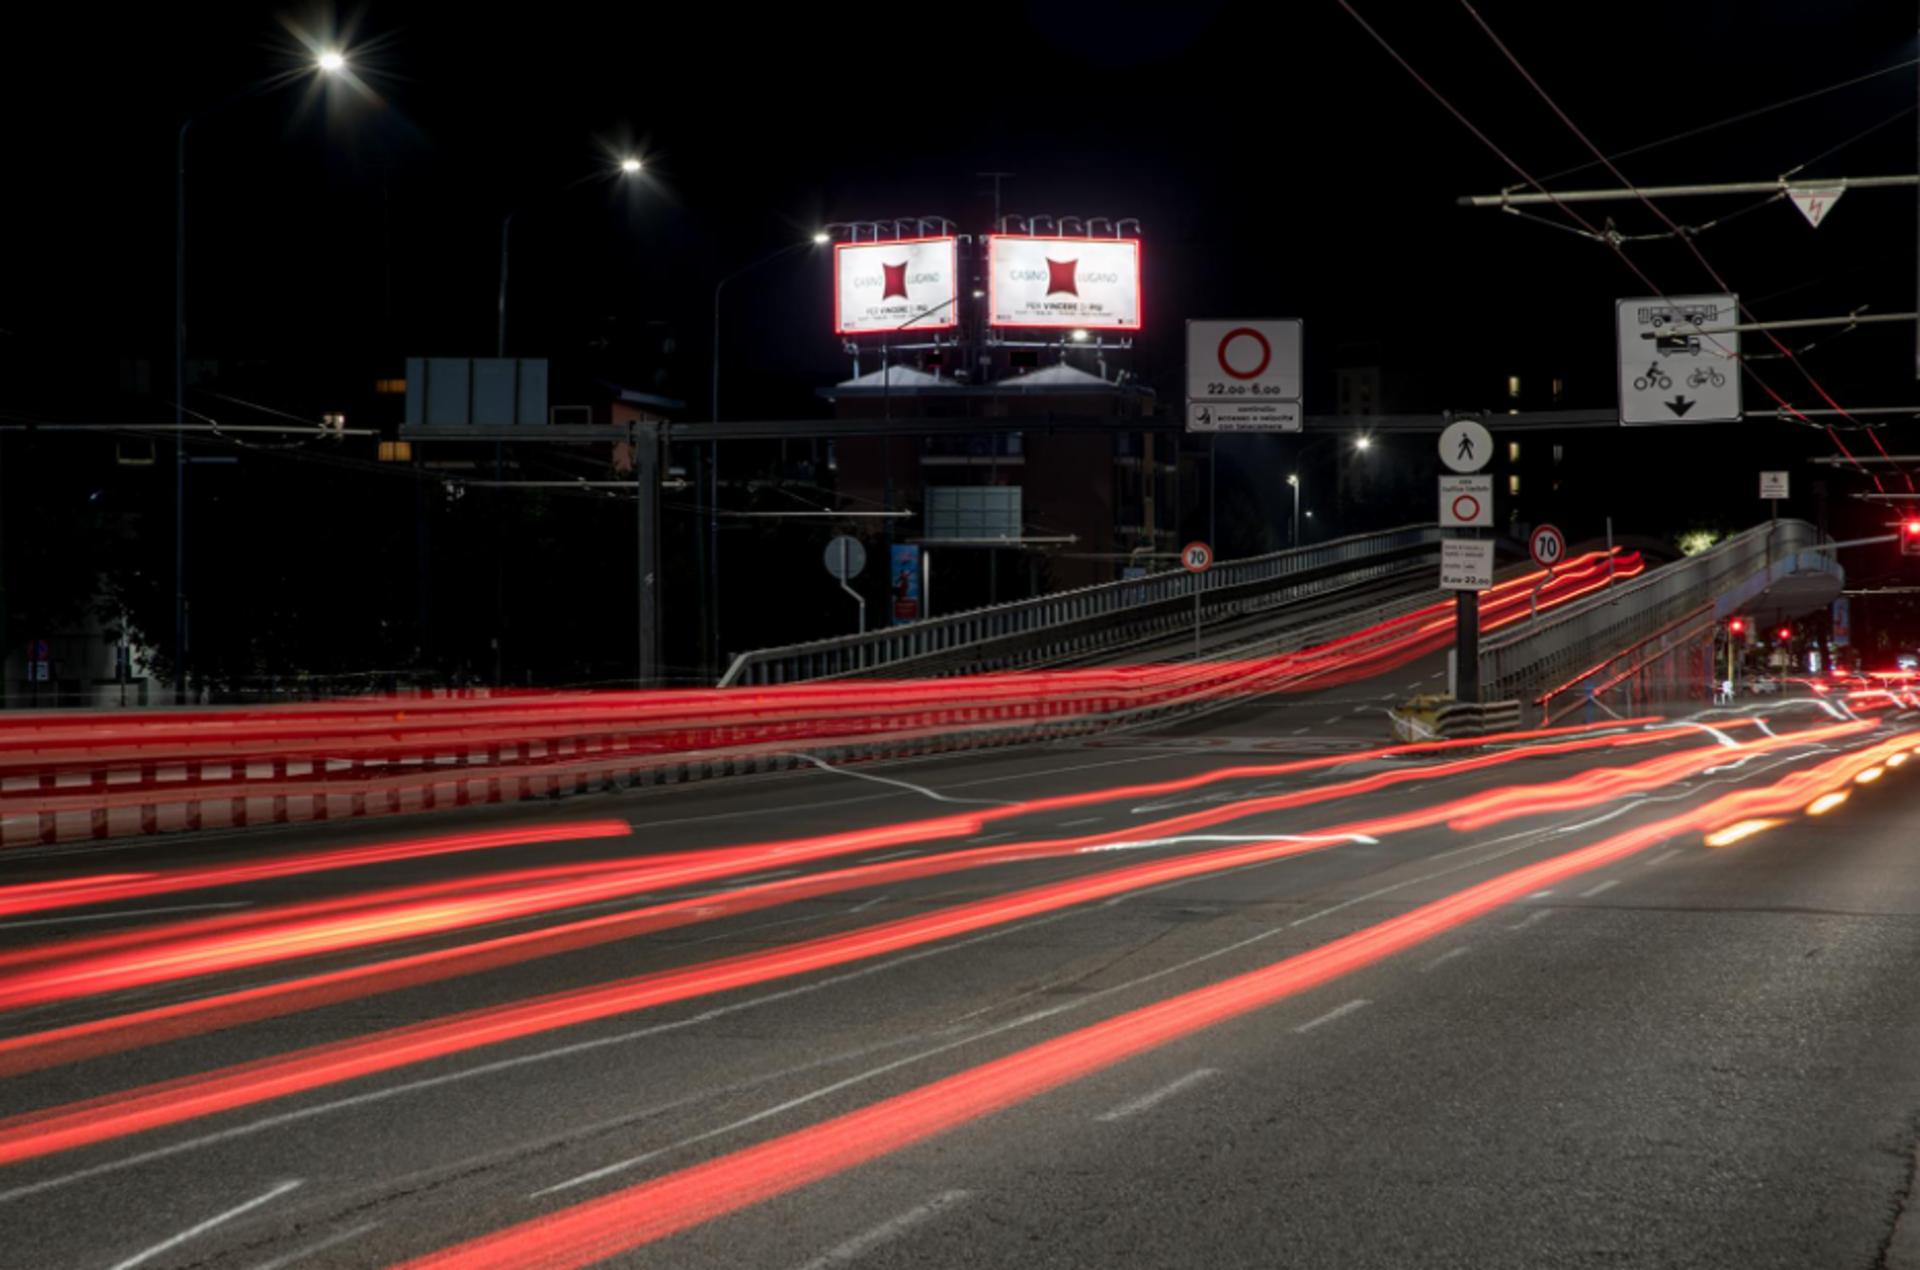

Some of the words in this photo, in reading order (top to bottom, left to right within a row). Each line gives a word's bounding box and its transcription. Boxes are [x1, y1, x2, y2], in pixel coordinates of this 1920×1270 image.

[854, 275, 883, 288] CASINO
[907, 272, 940, 284] LUGANO
[1009, 269, 1048, 281] CASINO
[1077, 271, 1118, 283] LUGANO
[1026, 302, 1041, 310] PER
[1043, 302, 1077, 311] VINCERE
[1539, 536, 1557, 557] 70
[1190, 549, 1206, 565] 70
